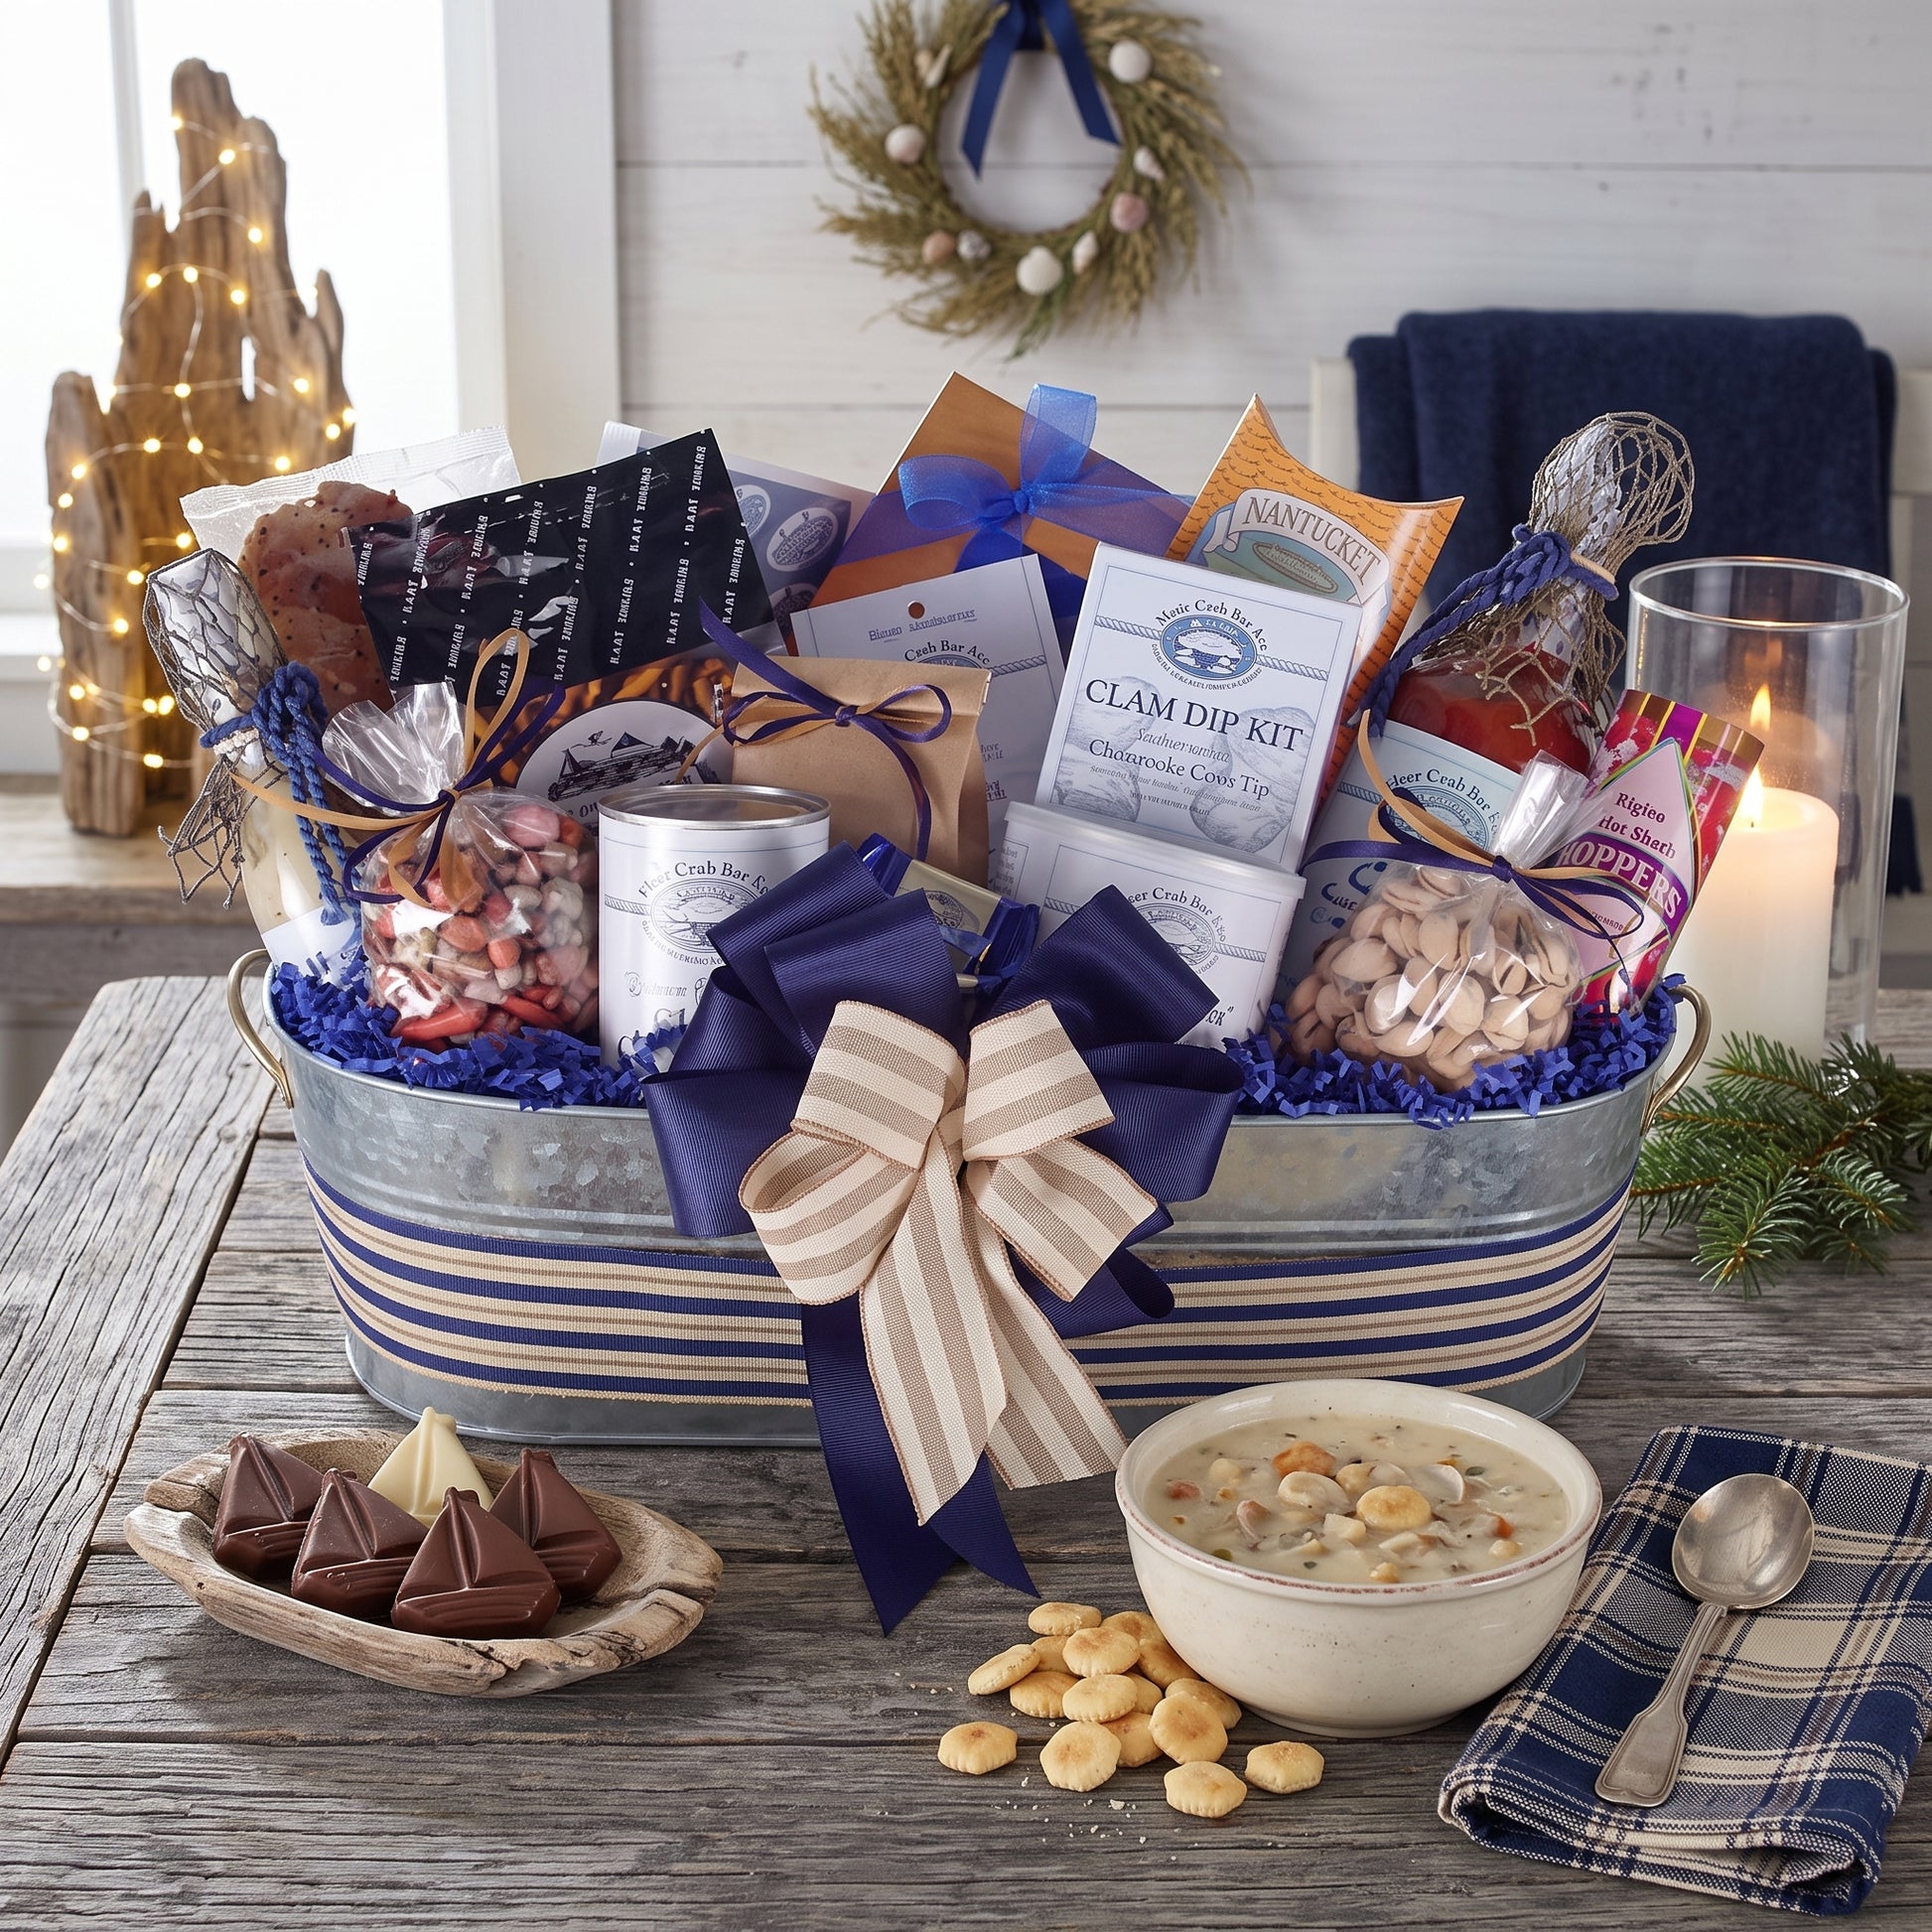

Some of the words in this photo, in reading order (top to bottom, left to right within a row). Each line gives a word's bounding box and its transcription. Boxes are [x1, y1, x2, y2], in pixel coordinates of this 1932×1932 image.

[1242, 496, 1381, 587] NANTUCKET
[940, 639, 965, 652] Bar
[1086, 679, 1178, 722] CLAM
[1183, 701, 1240, 735] DIP
[1245, 717, 1304, 752] KIT
[1240, 774, 1270, 800] Tip
[674, 860, 717, 877] Crab
[720, 862, 751, 882] Bar
[1152, 887, 1187, 905] Crab
